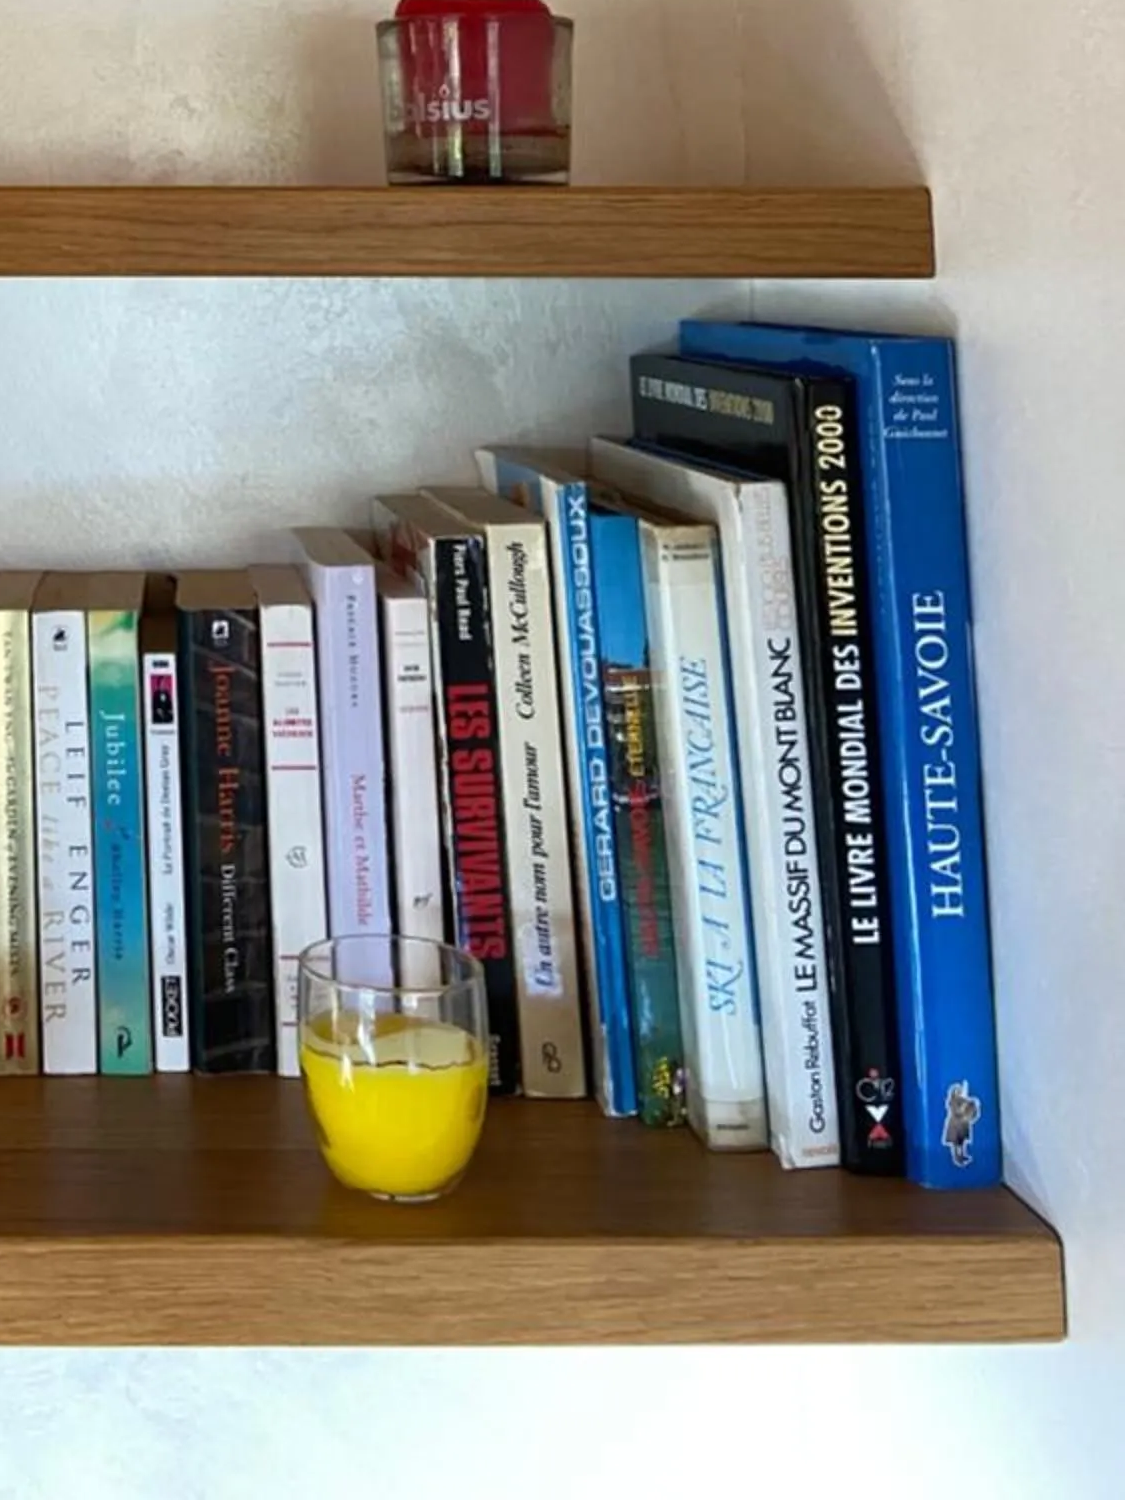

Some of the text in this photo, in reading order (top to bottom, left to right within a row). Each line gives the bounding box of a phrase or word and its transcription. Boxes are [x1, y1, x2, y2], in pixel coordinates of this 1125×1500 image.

[455, 578, 469, 606] Paul
[457, 608, 473, 641] Read
[506, 541, 537, 722] Colleen McCullough
[570, 493, 617, 902] GERARD DEVOUASSOUX
[767, 637, 797, 722] BLANC
[813, 403, 880, 944] LE LIVRE MONDIAL DES INVENTIONS 2000
[37, 684, 63, 795] PEACE
[99, 709, 127, 806] Jubilee
[520, 742, 544, 812] l'amour
[775, 725, 803, 813] MONT
[911, 590, 966, 919] HAUTE-SAVOIE
[65, 719, 92, 988] LEIF ENGER
[208, 661, 242, 994] Joanne Harris Different Class
[350, 772, 373, 926] Marthe et Mathilde
[447, 683, 506, 959] LES SURVIVANTS
[525, 814, 551, 859] pour
[783, 816, 807, 857] DU
[530, 863, 547, 904] nom
[696, 858, 728, 900] LA
[786, 860, 816, 961] MASSIF
[42, 909, 67, 1025] RIVER
[533, 905, 553, 958] autre
[703, 958, 744, 1016] SKI
[794, 964, 818, 993] LE
[809, 1070, 826, 1134] Gaston
